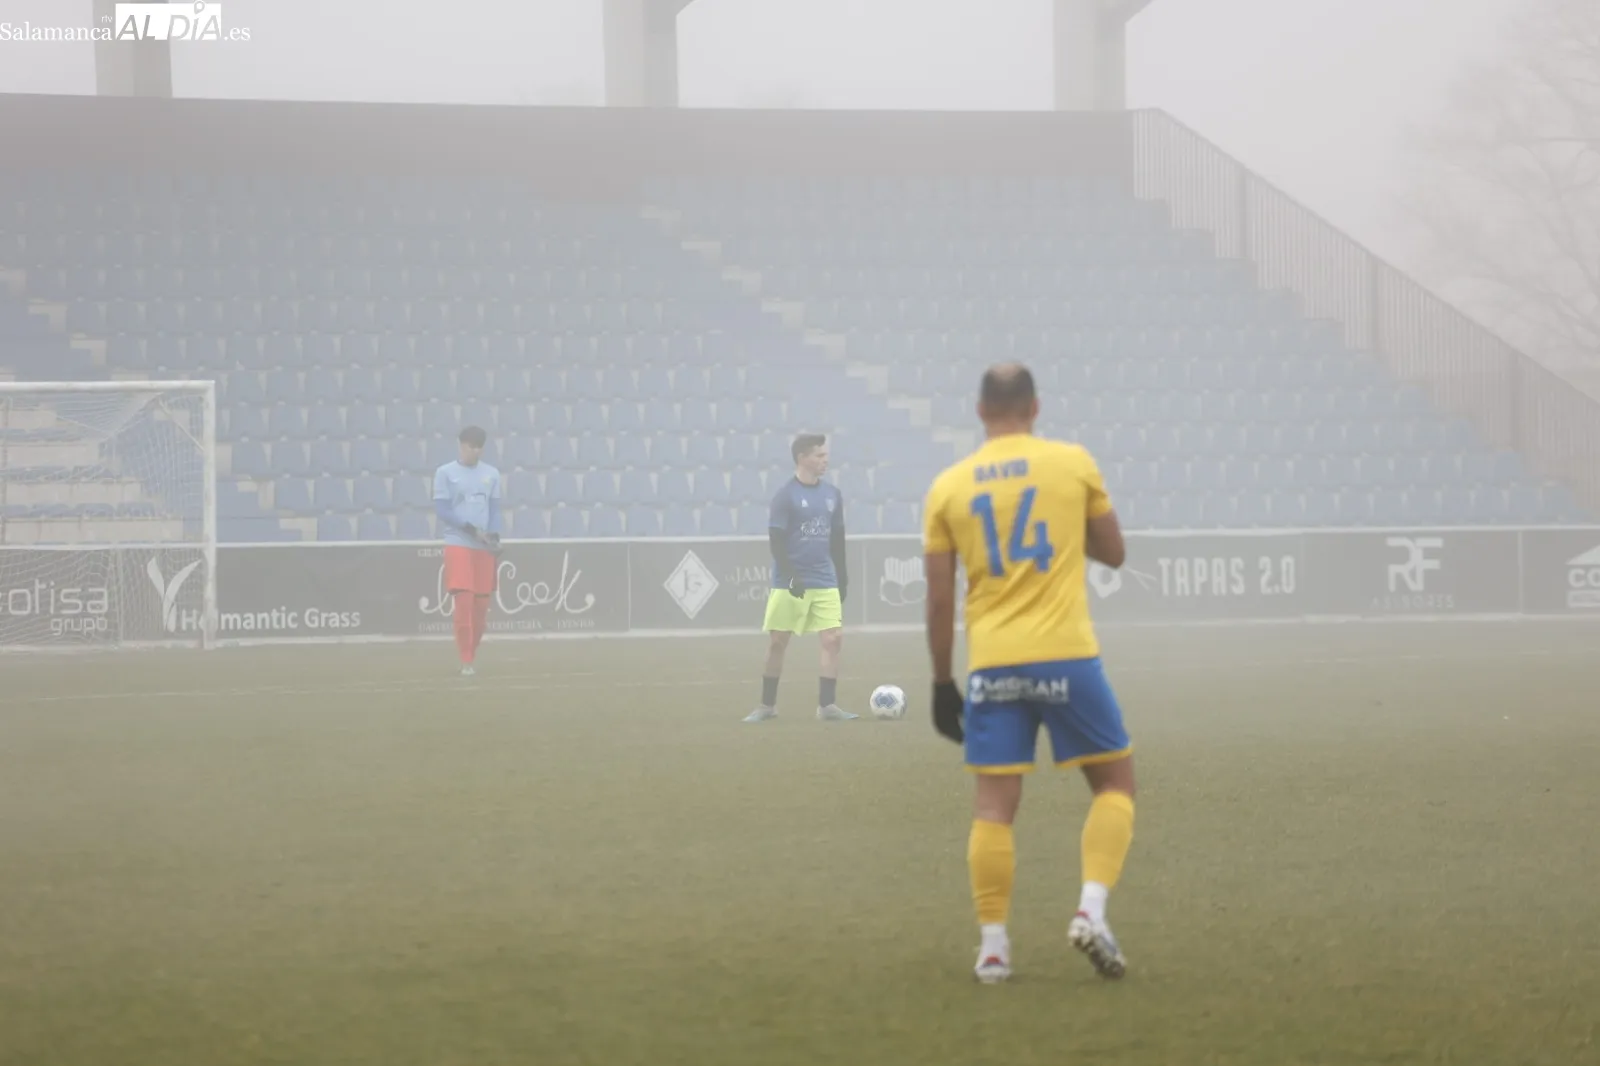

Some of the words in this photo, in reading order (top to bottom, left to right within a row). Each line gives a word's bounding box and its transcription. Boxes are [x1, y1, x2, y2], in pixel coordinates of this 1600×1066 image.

[969, 486, 1055, 577] 14
[1157, 557, 1245, 597] TAPAS
[1258, 555, 1296, 595] 2.0
[0, 578, 108, 615] otisa
[50, 615, 108, 636] grupo
[304, 607, 361, 629] Grass
